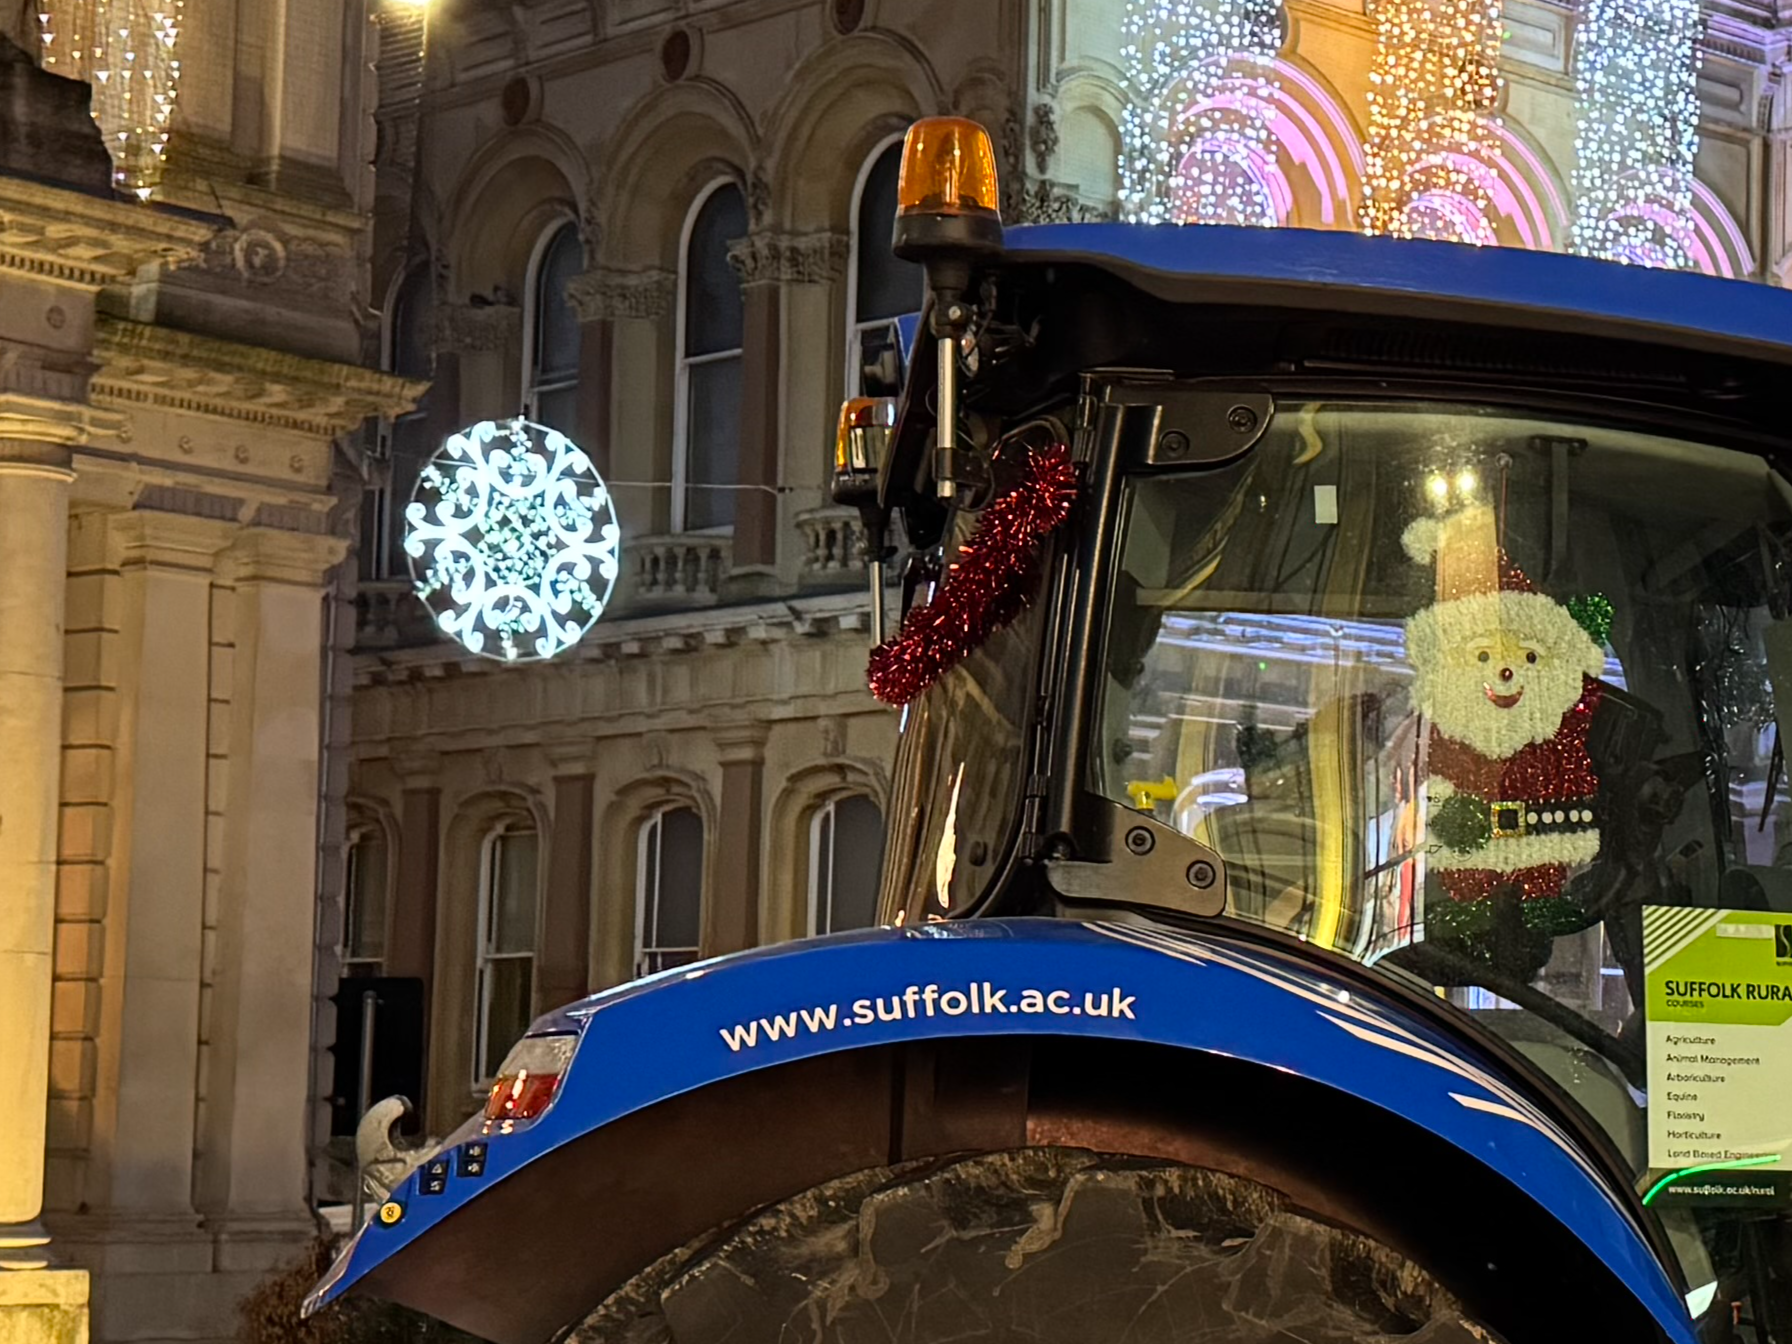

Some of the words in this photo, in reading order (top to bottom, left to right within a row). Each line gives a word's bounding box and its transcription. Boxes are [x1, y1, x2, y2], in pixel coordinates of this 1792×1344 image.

[1665, 980, 1742, 999] SUFFOLK
[1666, 1000, 1705, 1009] COURSES
[719, 981, 1137, 1052] www.suffolk.ac.uk
[1666, 1035, 1716, 1046] Agriculture
[1666, 1054, 1698, 1063] Animal
[1700, 1055, 1760, 1066] Management
[1667, 1073, 1725, 1083] Arboriculture
[1667, 1092, 1698, 1102] Equine
[1667, 1111, 1705, 1122] Floristry
[1667, 1130, 1721, 1140] Horticulture
[1668, 1150, 1690, 1158] Land
[1693, 1150, 1721, 1159] Based
